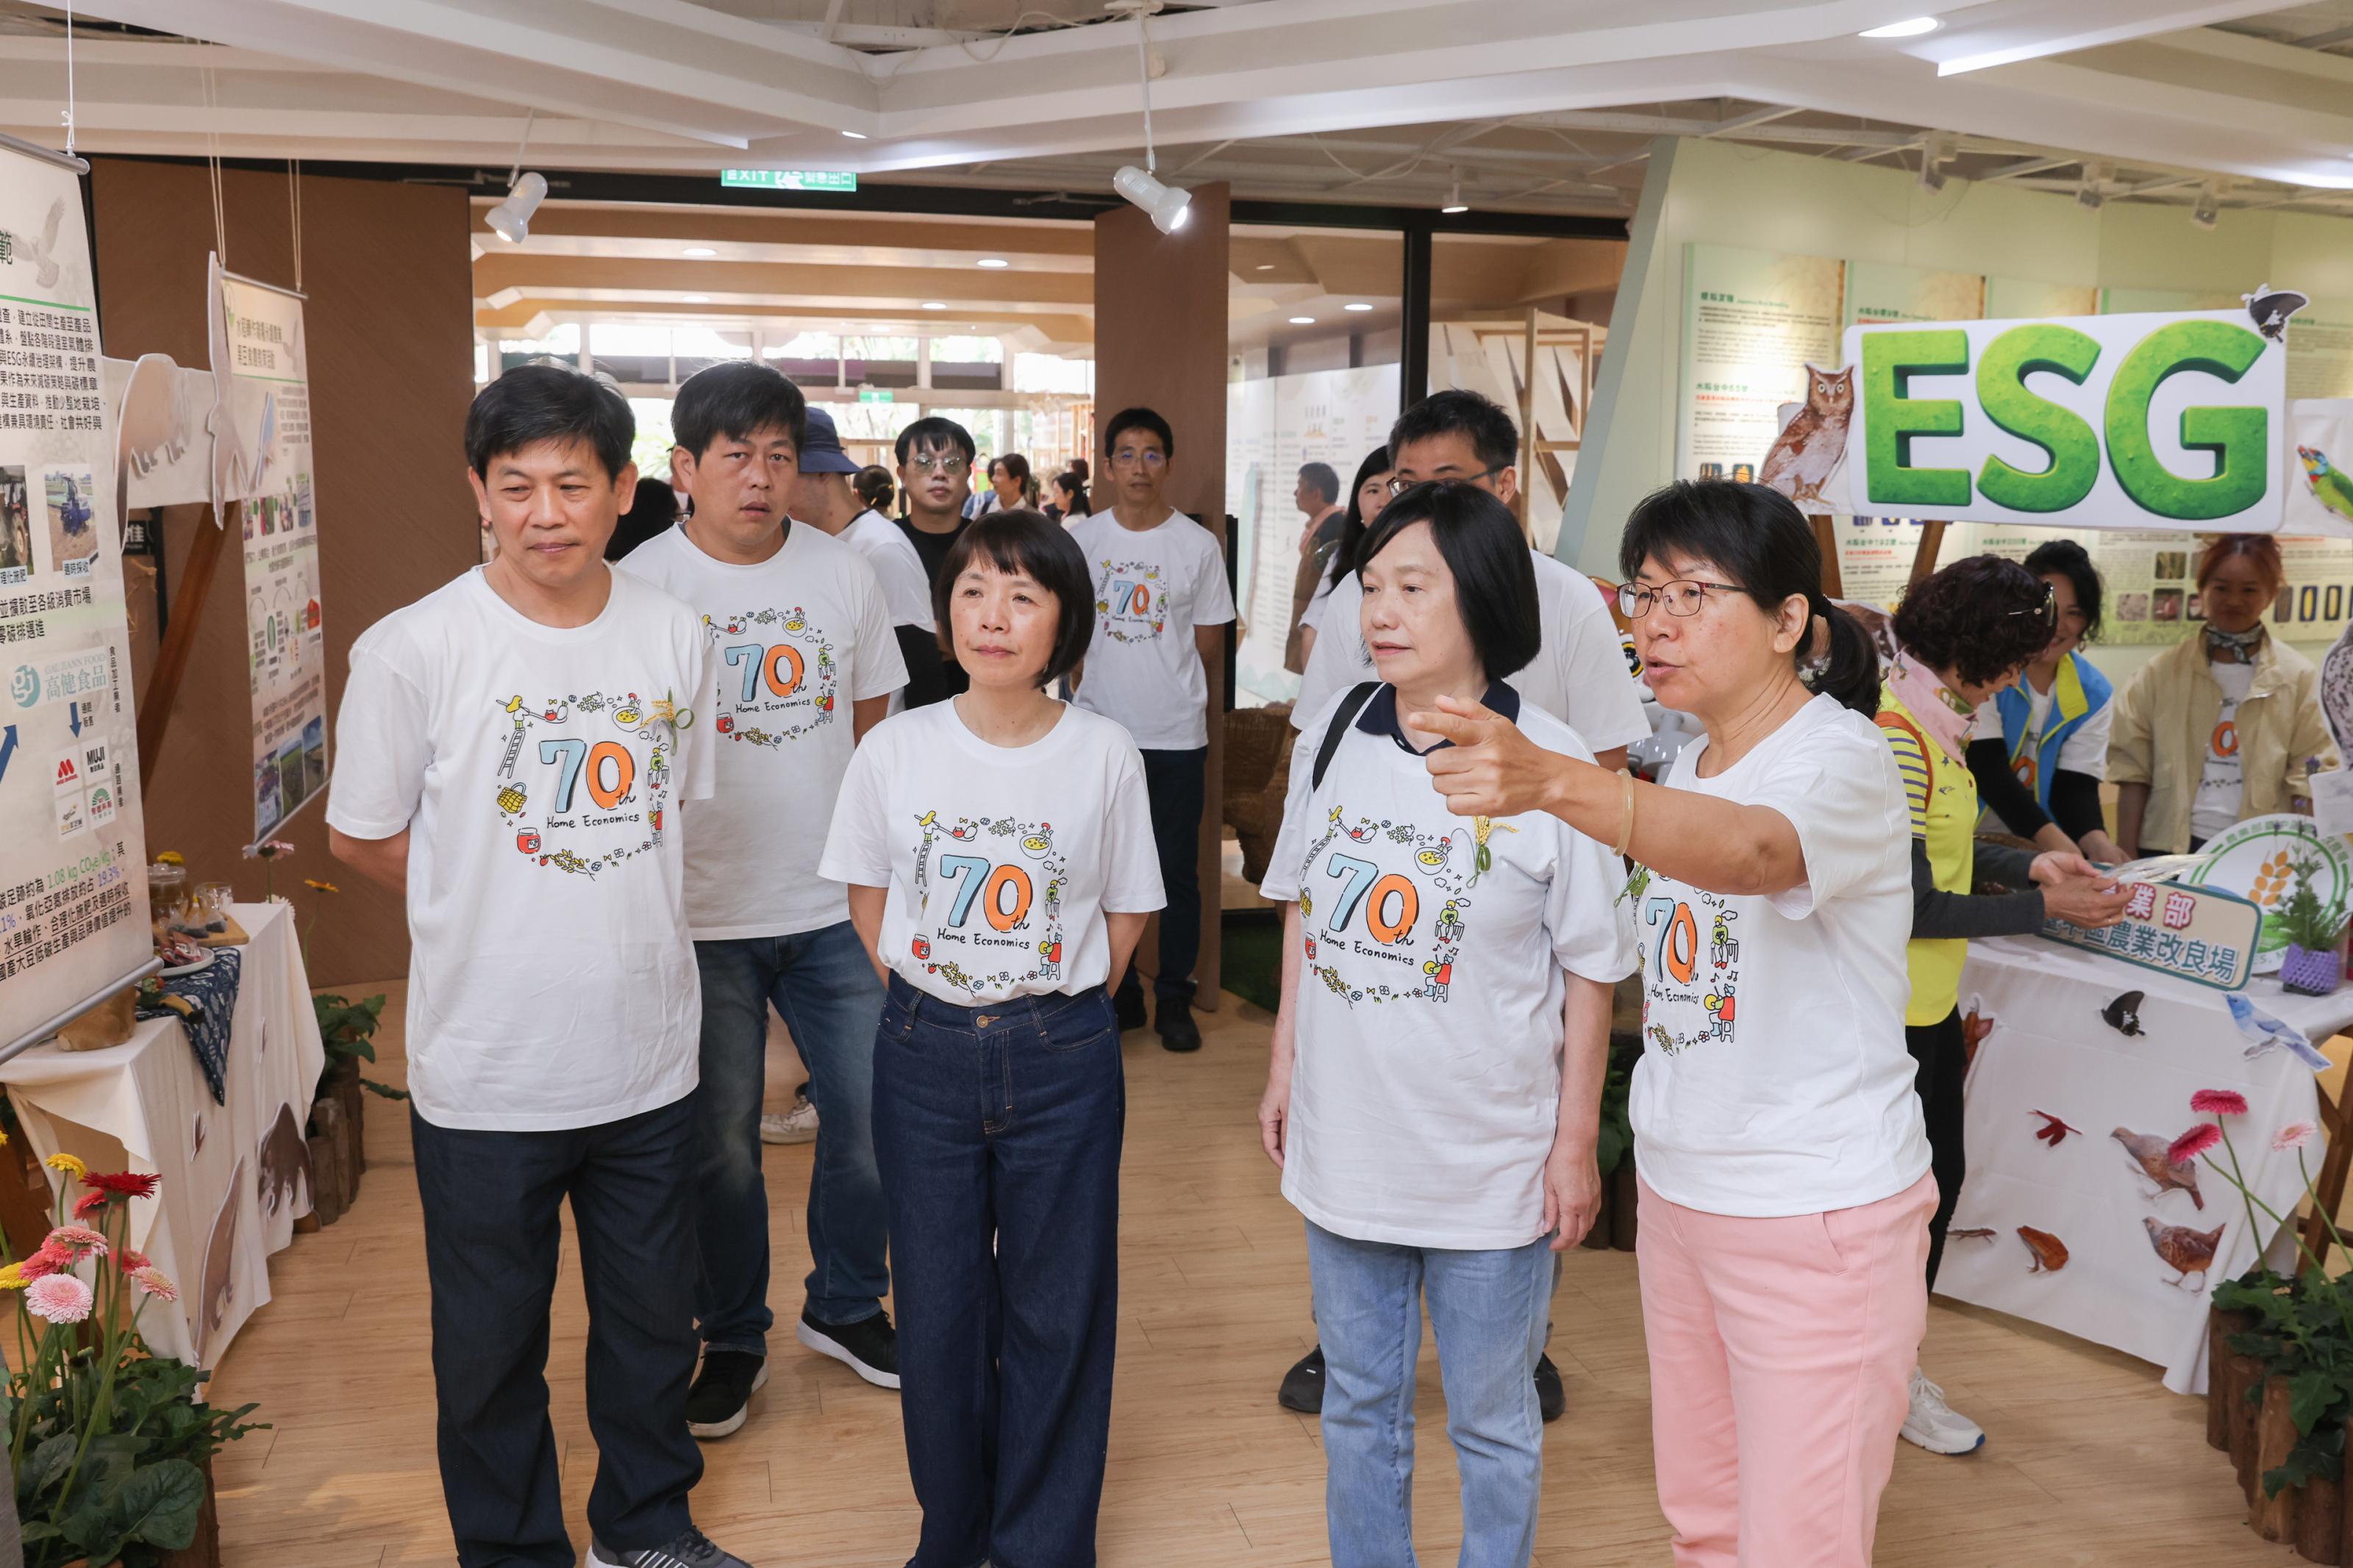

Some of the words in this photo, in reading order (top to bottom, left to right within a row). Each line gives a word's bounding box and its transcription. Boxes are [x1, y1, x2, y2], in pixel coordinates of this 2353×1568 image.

[726, 169, 770, 182] EXIT
[0, 413, 102, 430] 構兼具環境責任、社會共好與
[1861, 318, 2268, 520] ESG
[84, 653, 107, 665] FOOD
[724, 643, 807, 702] 70th
[46, 664, 107, 700] 高健食品
[736, 704, 760, 713] Home
[765, 698, 810, 712] Economics
[87, 746, 105, 765] MUJI
[539, 739, 636, 813] 70th
[547, 816, 576, 828] Home
[582, 812, 640, 826] Economics
[47, 869, 65, 889] 1.08
[67, 865, 78, 882] kg
[940, 854, 1033, 933] 70th
[1327, 853, 1419, 947] 70th
[2101, 882, 2196, 930] 業部
[938, 928, 966, 943] Home
[974, 934, 1030, 949] Economics
[1320, 929, 1346, 950] Home
[1354, 941, 1414, 966] Economics
